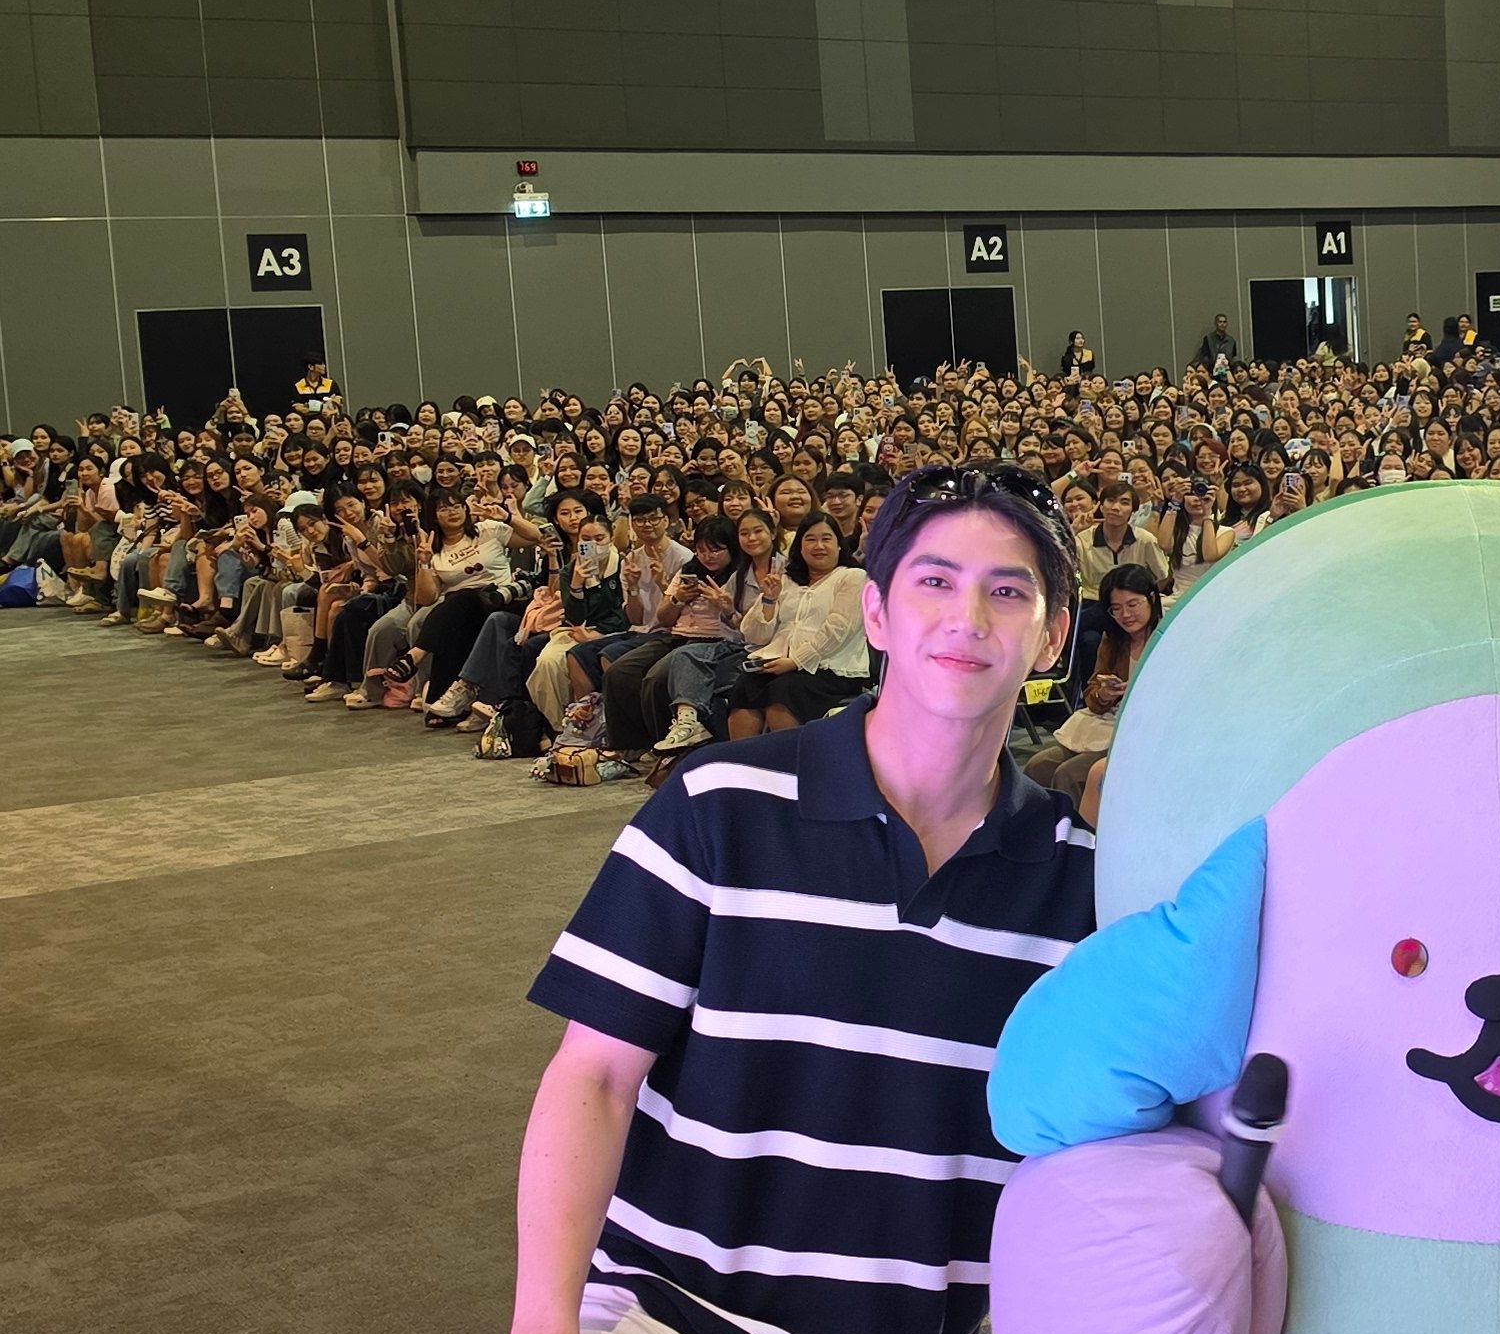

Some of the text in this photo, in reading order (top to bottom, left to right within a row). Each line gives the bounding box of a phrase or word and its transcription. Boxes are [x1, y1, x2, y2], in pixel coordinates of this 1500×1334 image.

[970, 236, 1004, 261] A2
[1322, 231, 1346, 255] A1
[256, 247, 302, 277] A3
